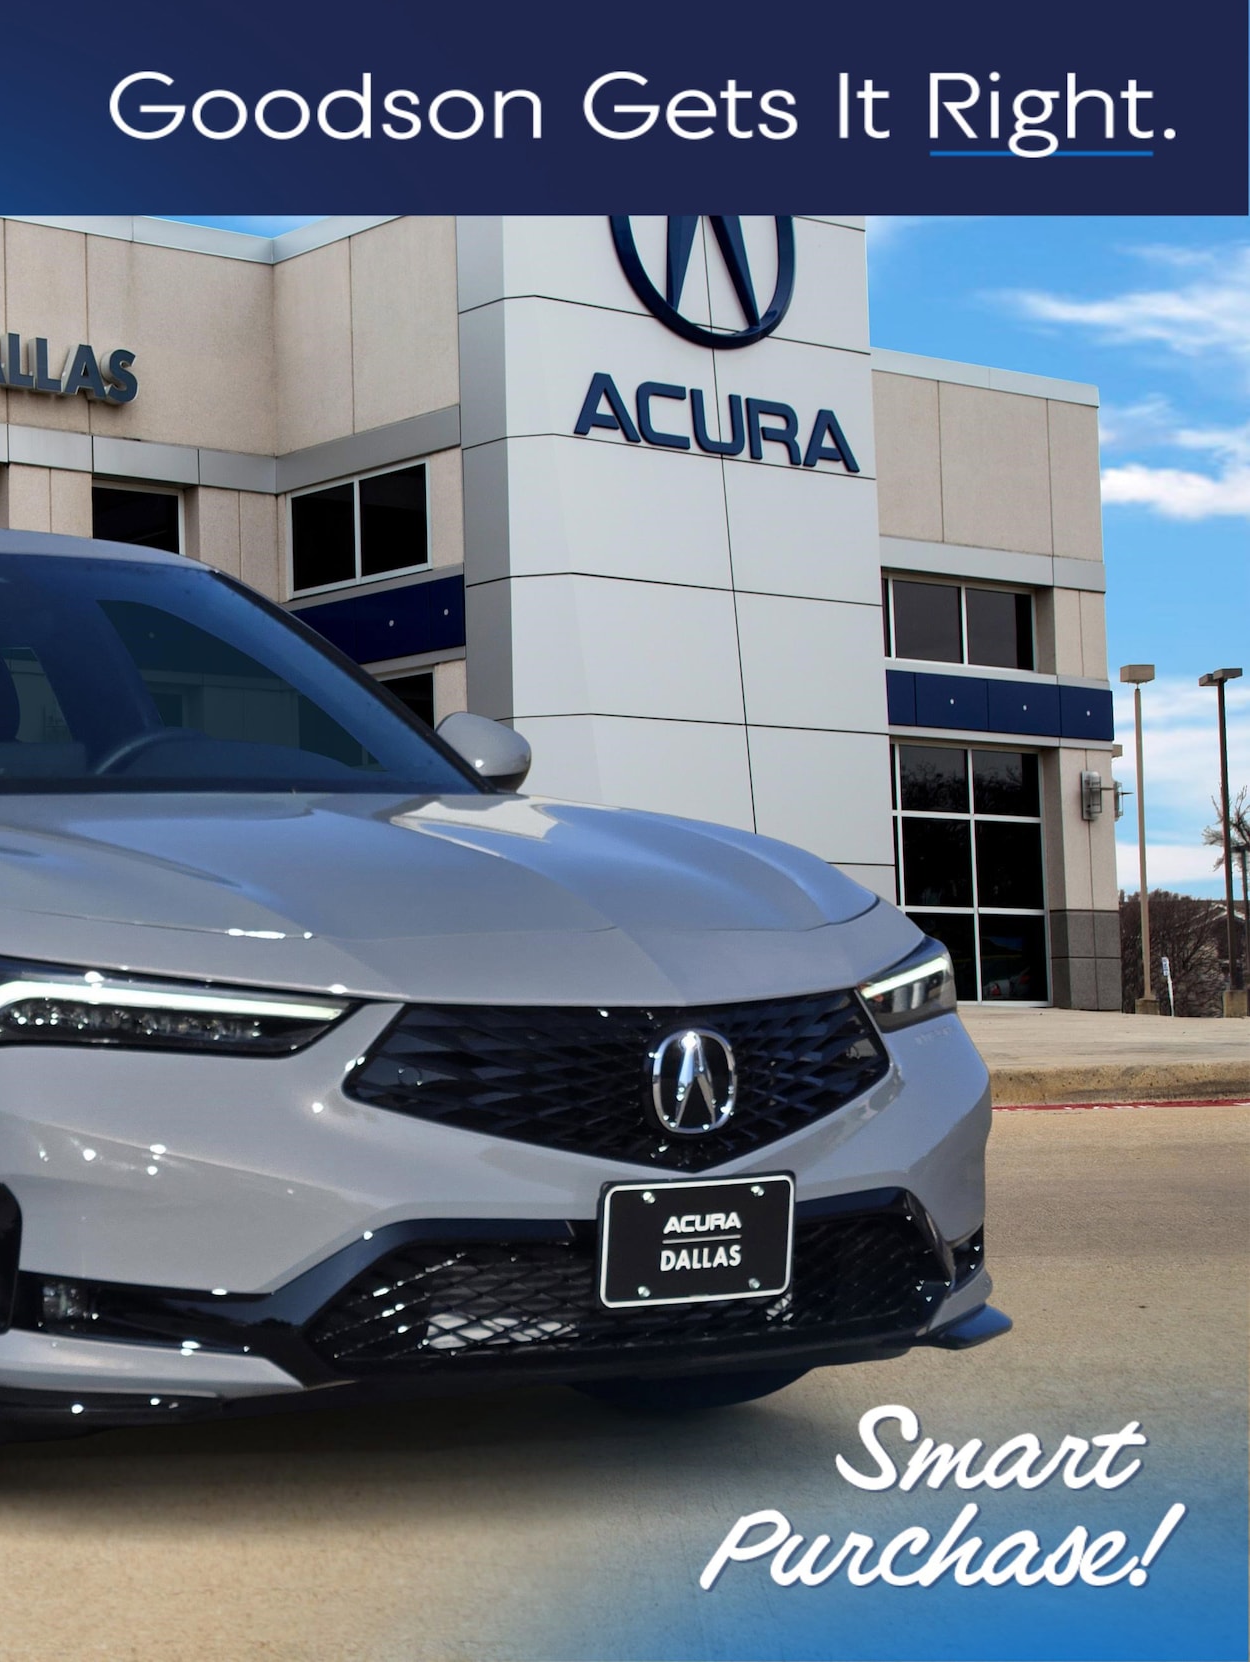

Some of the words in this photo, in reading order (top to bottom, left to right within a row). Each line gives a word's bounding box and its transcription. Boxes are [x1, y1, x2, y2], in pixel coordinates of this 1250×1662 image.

[573, 371, 860, 473] ACURA
[663, 1211, 742, 1234] ACURA
[660, 1244, 742, 1271] DALLAS
